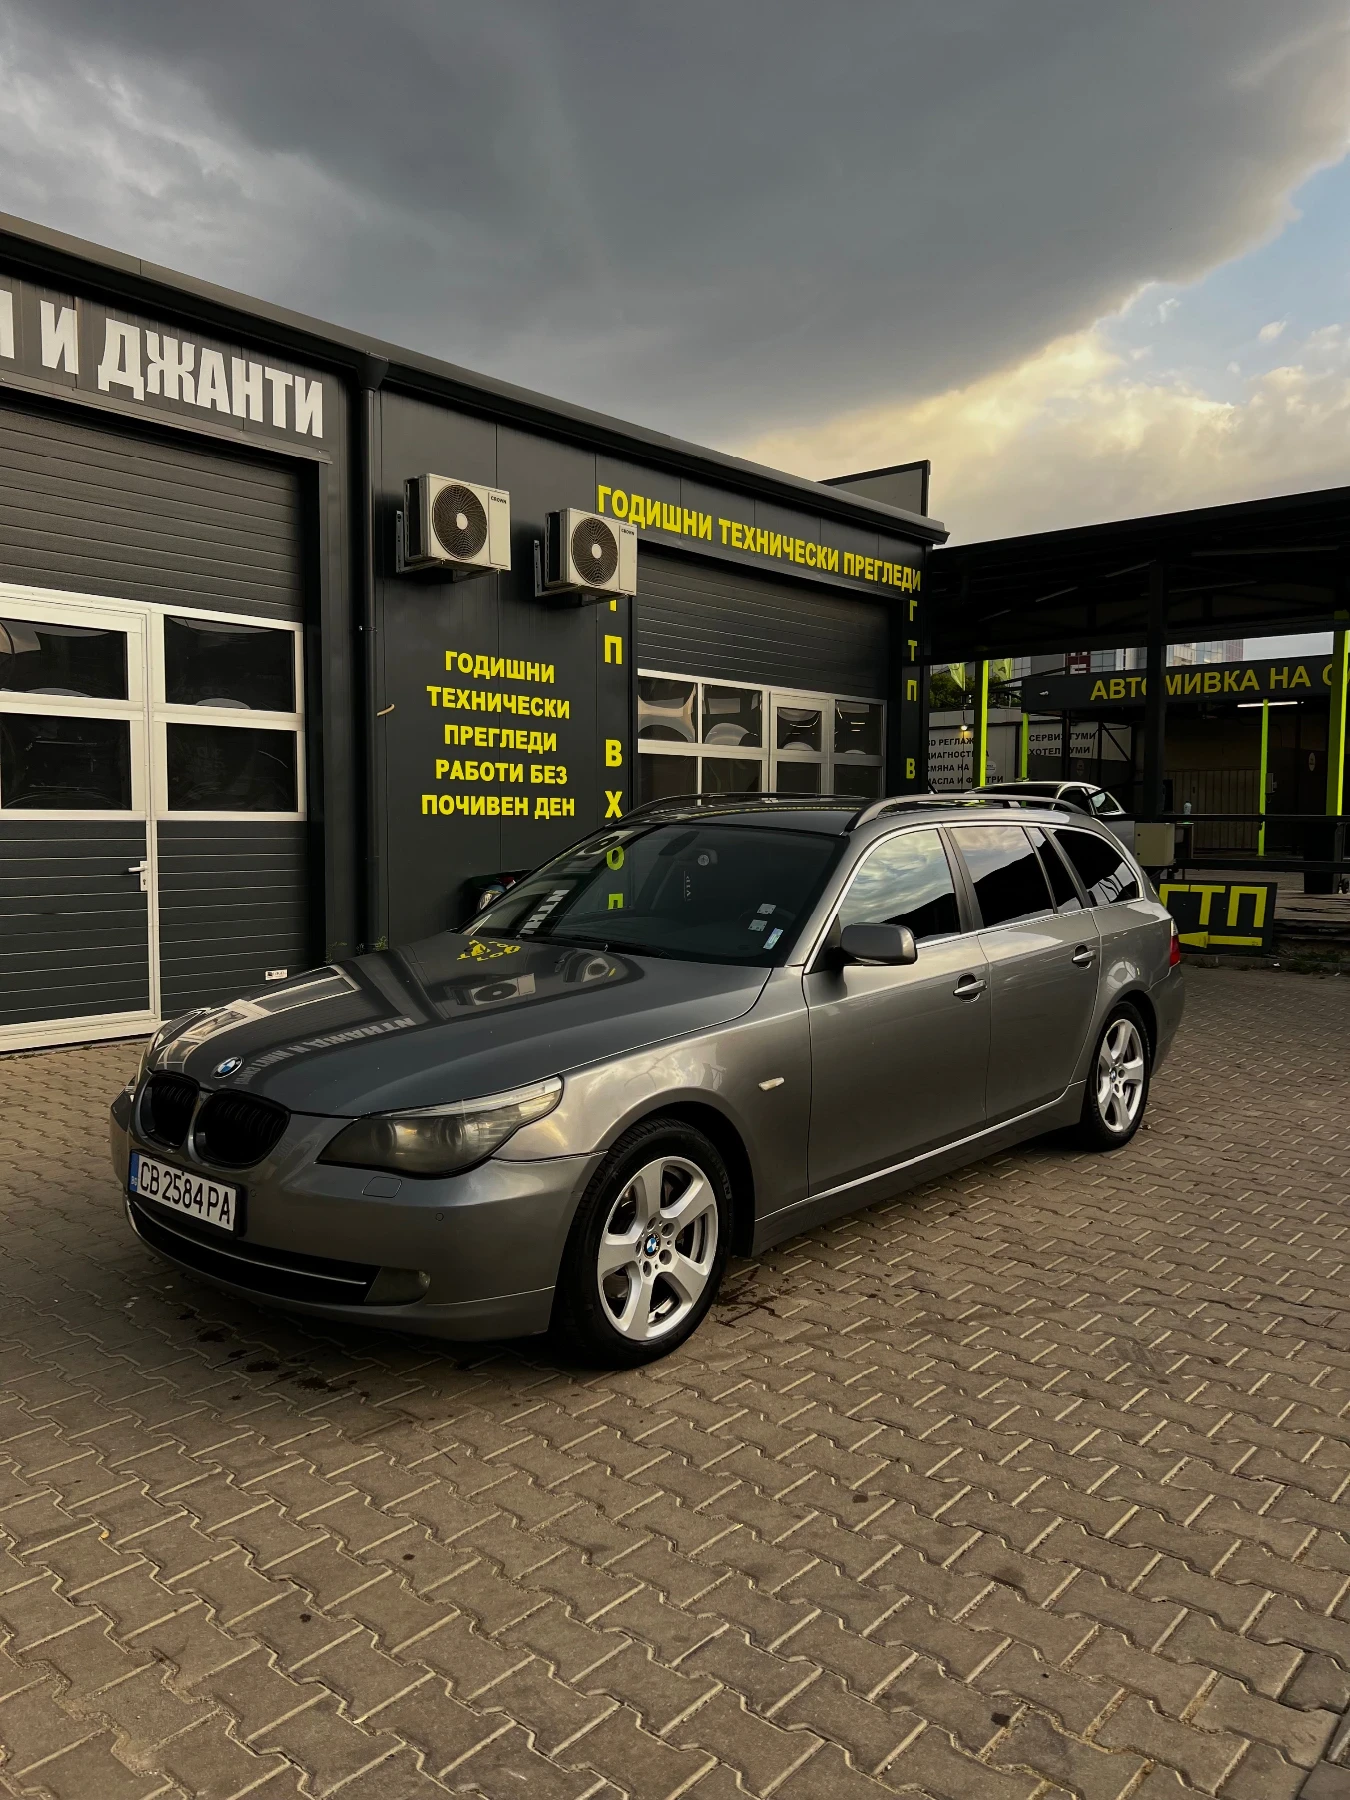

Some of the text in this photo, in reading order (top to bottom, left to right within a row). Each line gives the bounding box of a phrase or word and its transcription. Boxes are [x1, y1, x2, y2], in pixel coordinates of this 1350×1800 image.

[40, 299, 79, 375] И
[97, 317, 323, 439] ДЖАНТИ
[490, 495, 507, 505] CROWN
[597, 484, 921, 592] ГОДИШНИ ТЕХНИЧЕСКИ ПРЕГЛЕДИ
[620, 528, 635, 536] CROWN
[445, 650, 555, 684] ГОДИШНИ
[1090, 670, 1259, 700] АВТМИВКА
[1269, 665, 1311, 690] НА
[426, 685, 570, 719] ТЕХНИЧЕСКИ
[444, 723, 557, 755] ПРЕГЛЕДИ
[1029, 733, 1063, 742] СЕРВИ
[1029, 747, 1061, 756] ХОТЕЛ
[435, 758, 568, 785] РАБОТИ БЕЗ
[957, 763, 969, 771] НА
[421, 794, 575, 820] ПОЧИВЕН ДЕН
[1158, 883, 1268, 928] ГТП
